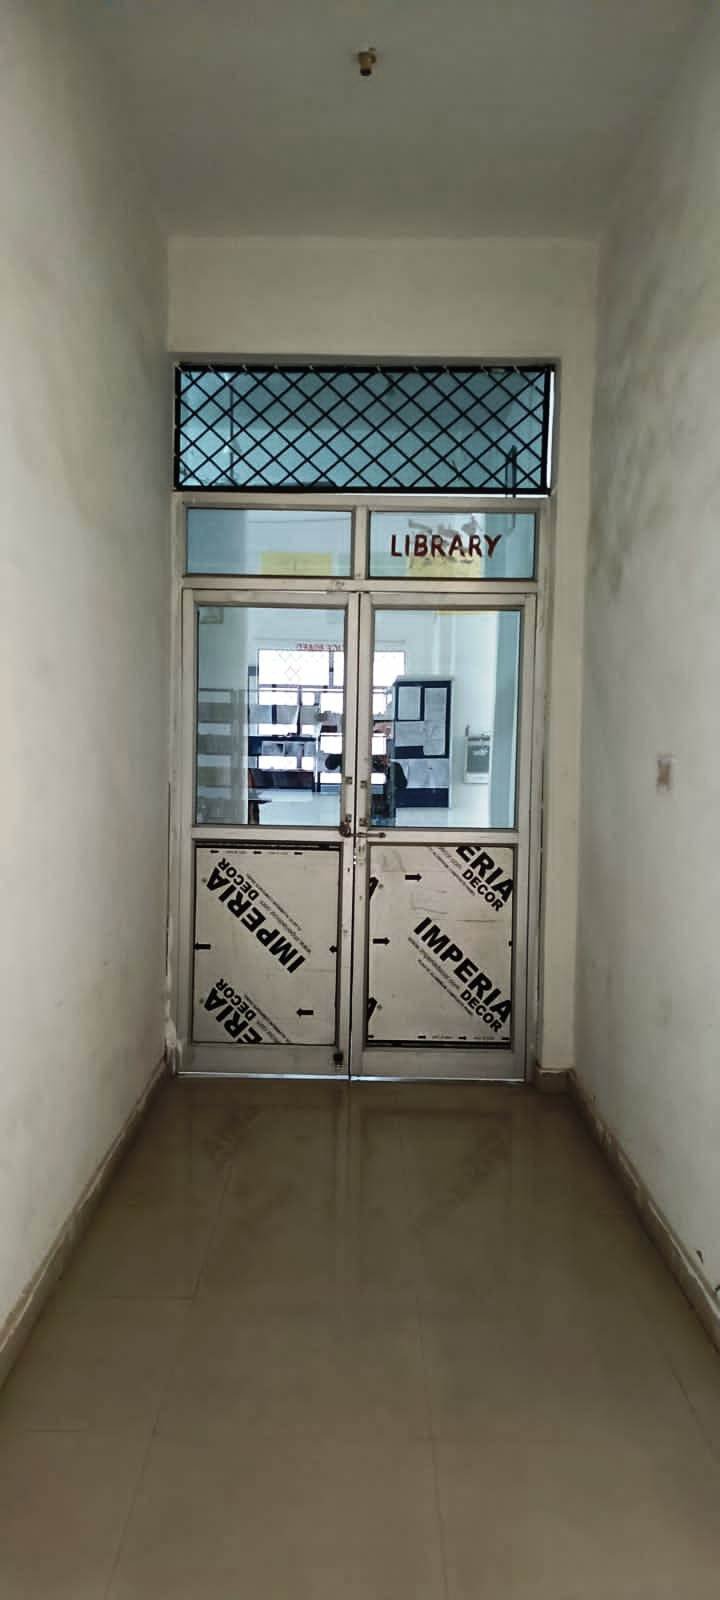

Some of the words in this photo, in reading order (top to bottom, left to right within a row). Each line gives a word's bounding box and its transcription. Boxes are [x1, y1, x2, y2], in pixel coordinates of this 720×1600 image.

[390, 534, 502, 558] LIBRARY
[217, 857, 260, 902] DECOR
[461, 868, 504, 912] DECOR
[206, 866, 306, 974] IMPERIA
[413, 916, 513, 1023] IMPERIA
[214, 977, 258, 1023] DECOR
[459, 988, 503, 1034] DECOR
